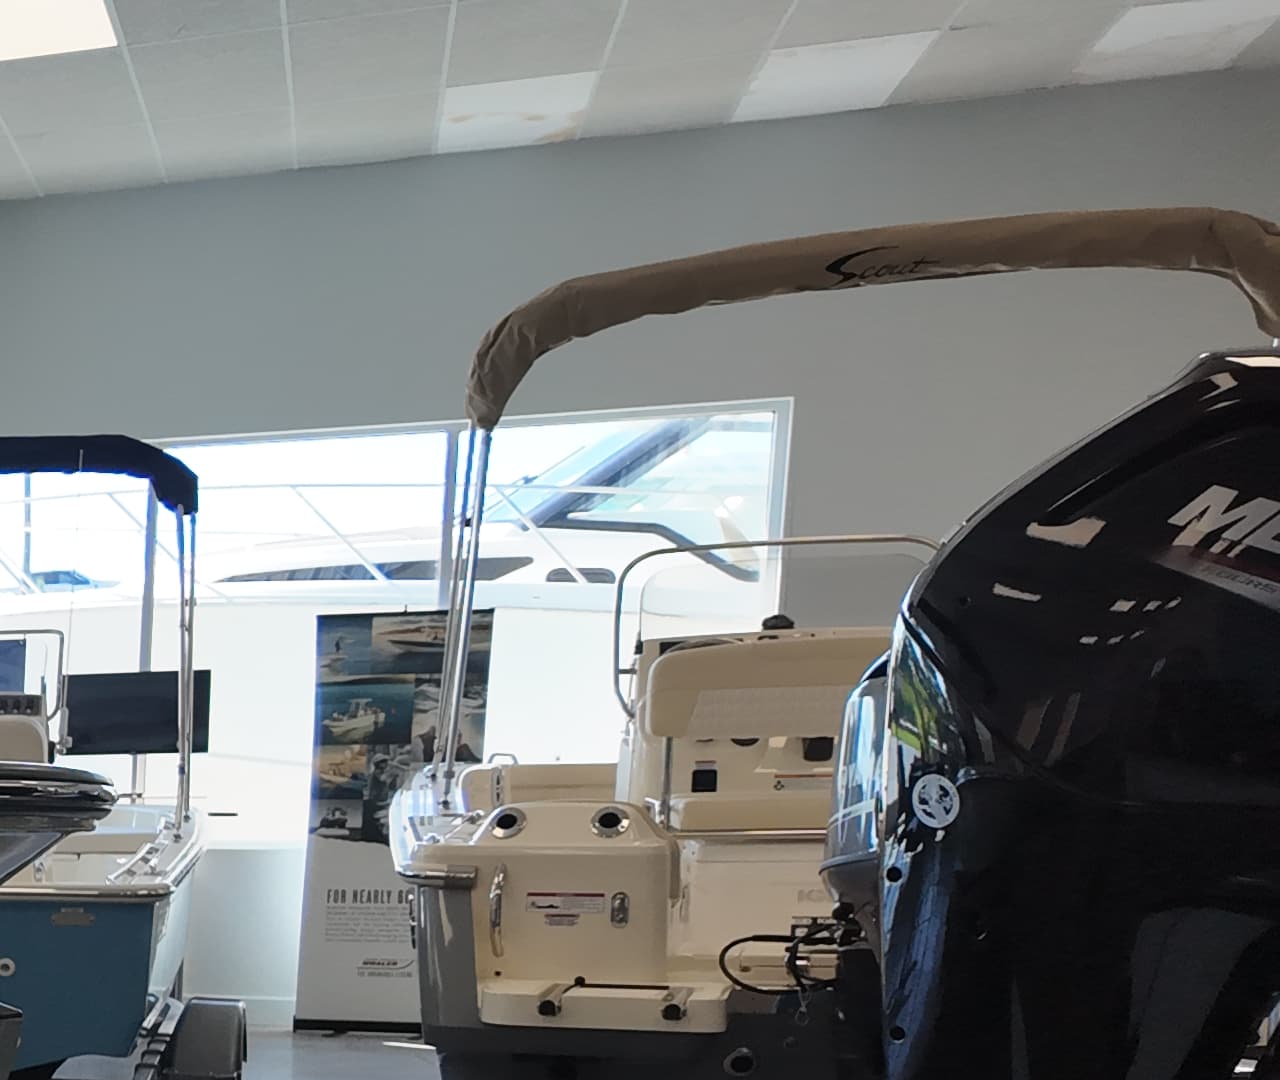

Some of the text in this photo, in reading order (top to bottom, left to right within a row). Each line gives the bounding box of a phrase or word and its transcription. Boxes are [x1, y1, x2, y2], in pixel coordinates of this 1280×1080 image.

[825, 246, 942, 287] Scout
[327, 889, 346, 904] FOR
[352, 889, 392, 904] NEARLY
